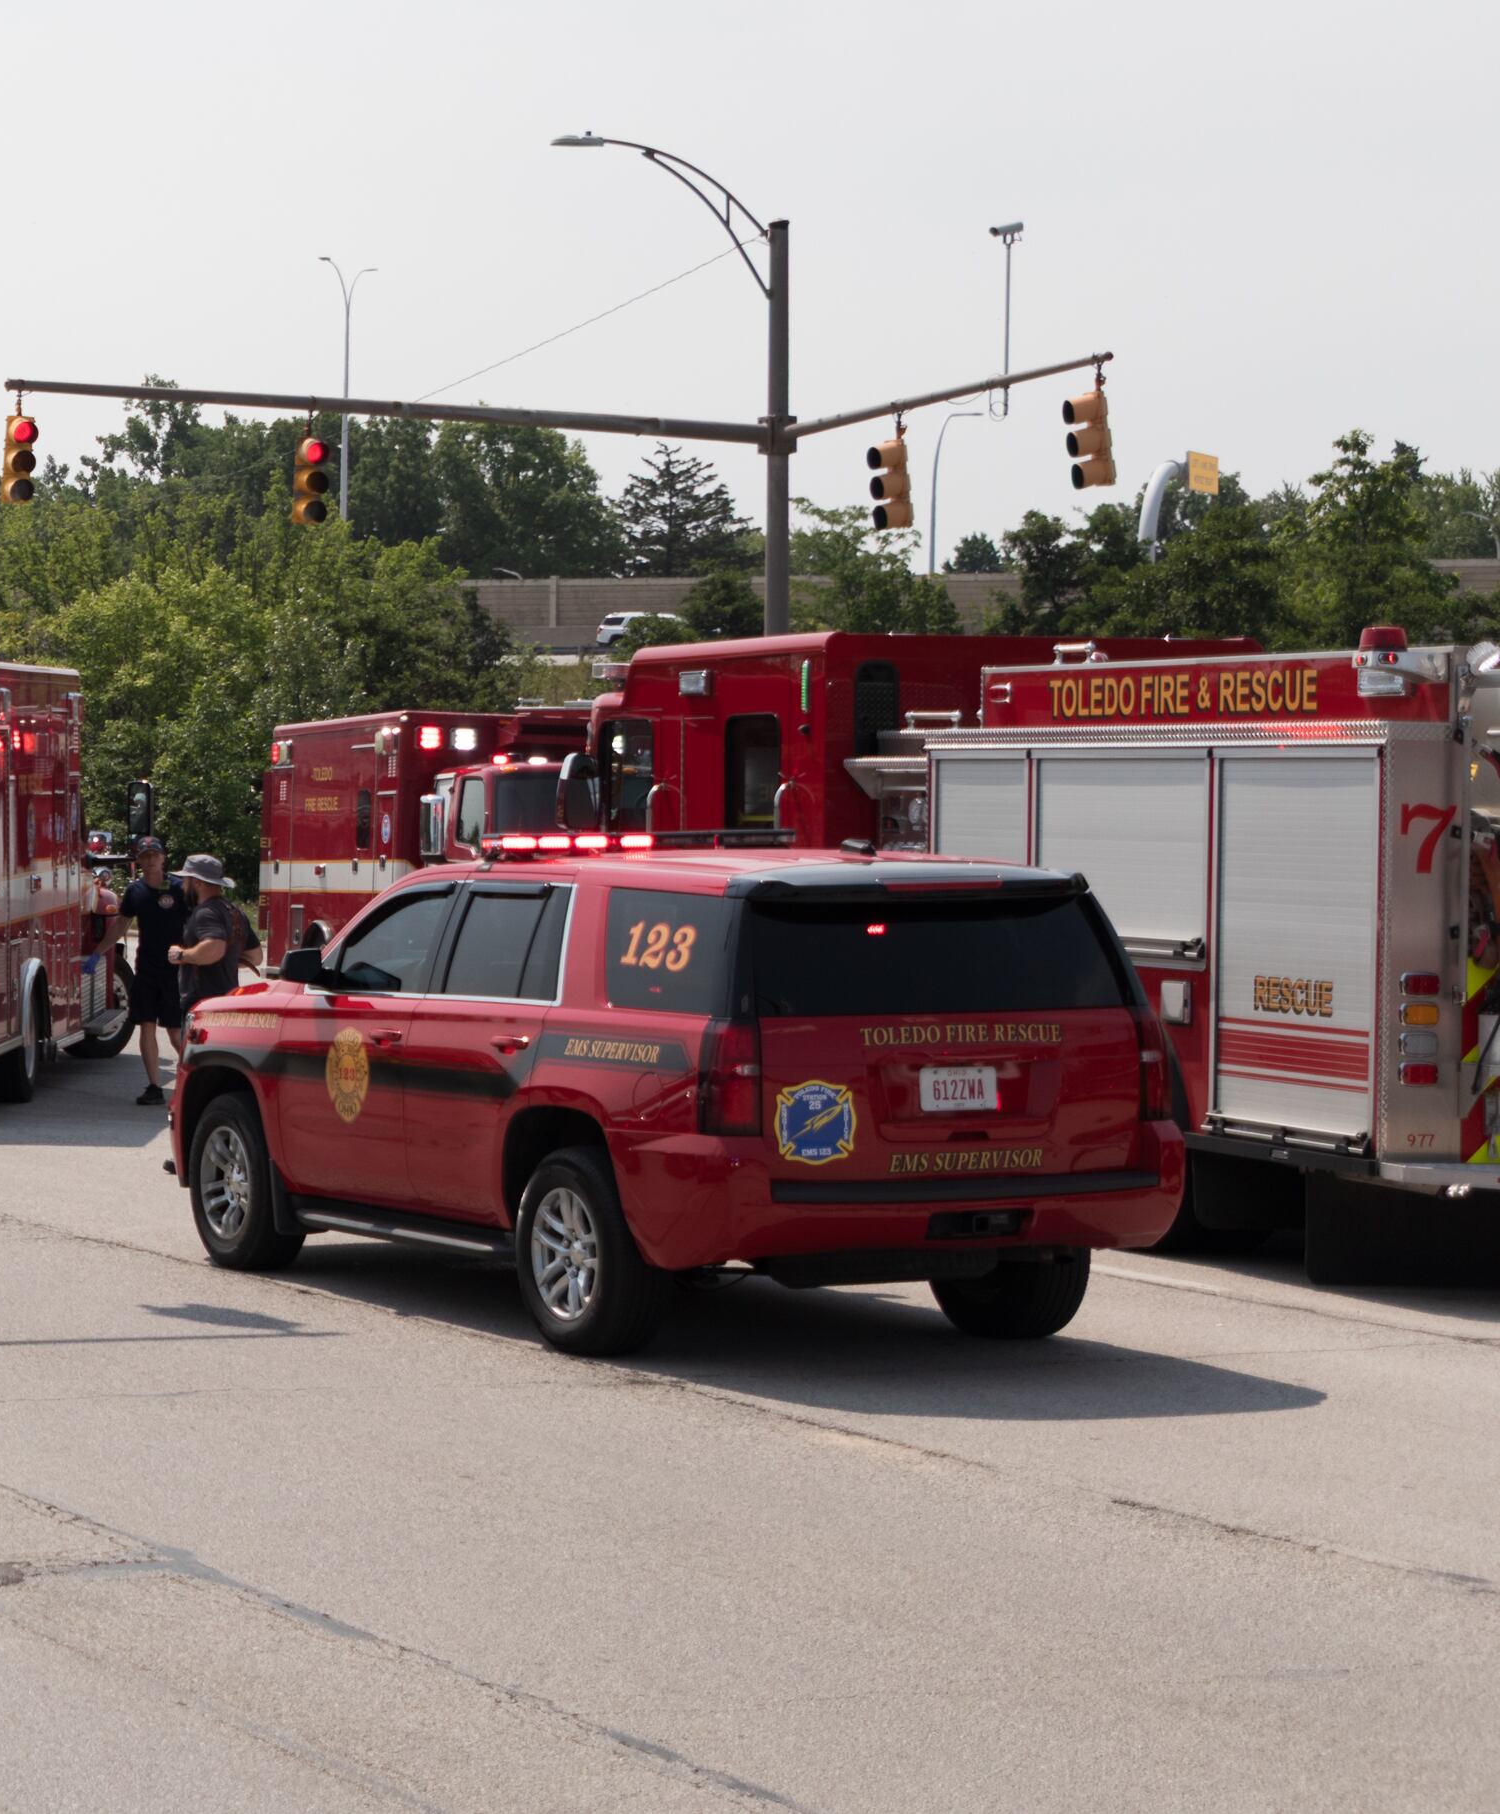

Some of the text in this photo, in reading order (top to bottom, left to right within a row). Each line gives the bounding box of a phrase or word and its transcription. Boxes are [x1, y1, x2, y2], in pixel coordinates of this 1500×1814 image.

[1050, 669, 1318, 718] TOLEDO FIRE & RESCUE
[312, 767, 333, 781] TOLEDO
[1401, 803, 1457, 874] 7
[619, 920, 698, 972] 123
[1254, 975, 1333, 1018] RESCUE
[860, 1024, 1062, 1046] TOLEDO FIRE RESCUE
[564, 1038, 660, 1063] EMS SUPERVISOR
[339, 1067, 356, 1081] 123
[933, 1078, 985, 1100] 612ZWA
[1407, 1134, 1435, 1147] 977
[888, 1149, 1044, 1173] EMS SUPERVISOR
